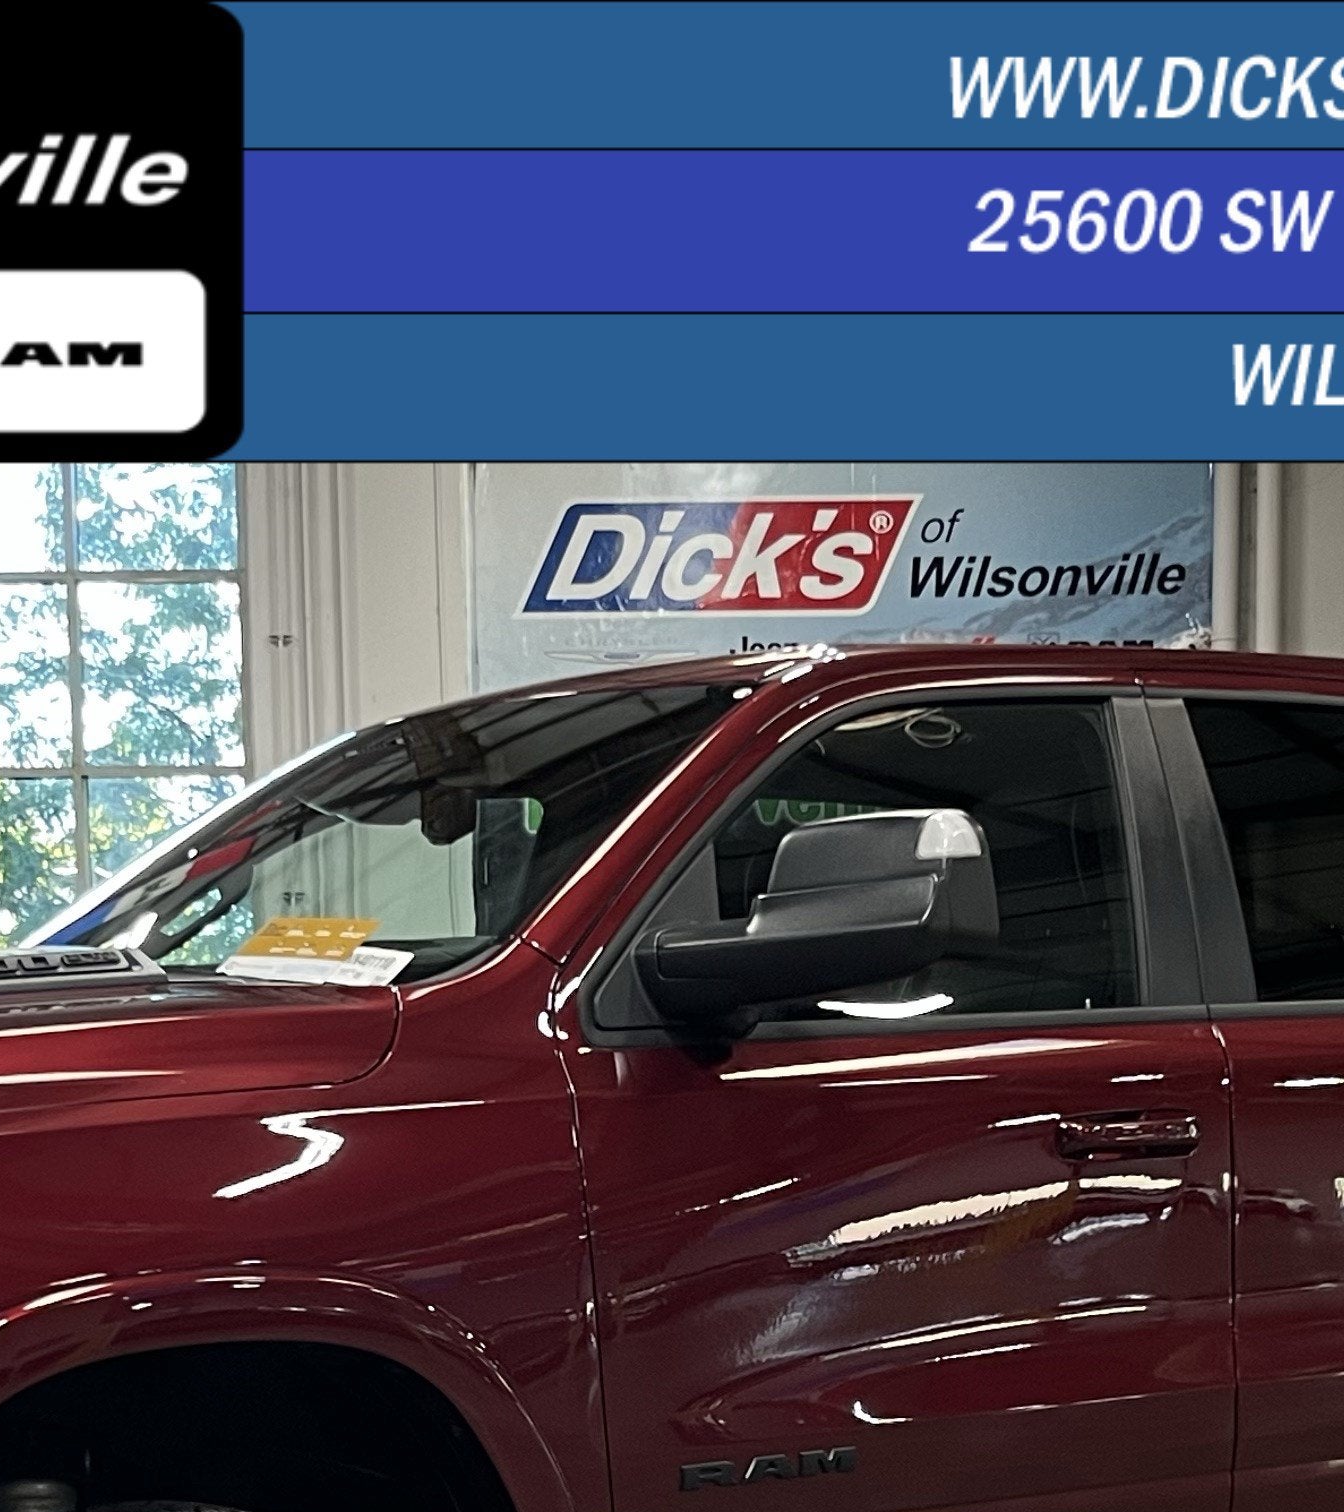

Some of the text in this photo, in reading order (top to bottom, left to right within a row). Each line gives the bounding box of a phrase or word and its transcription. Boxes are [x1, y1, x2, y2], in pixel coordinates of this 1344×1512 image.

[546, 509, 964, 602] Dick's of
[909, 551, 1187, 599] Wilsonville
[679, 1446, 856, 1490] RAM
